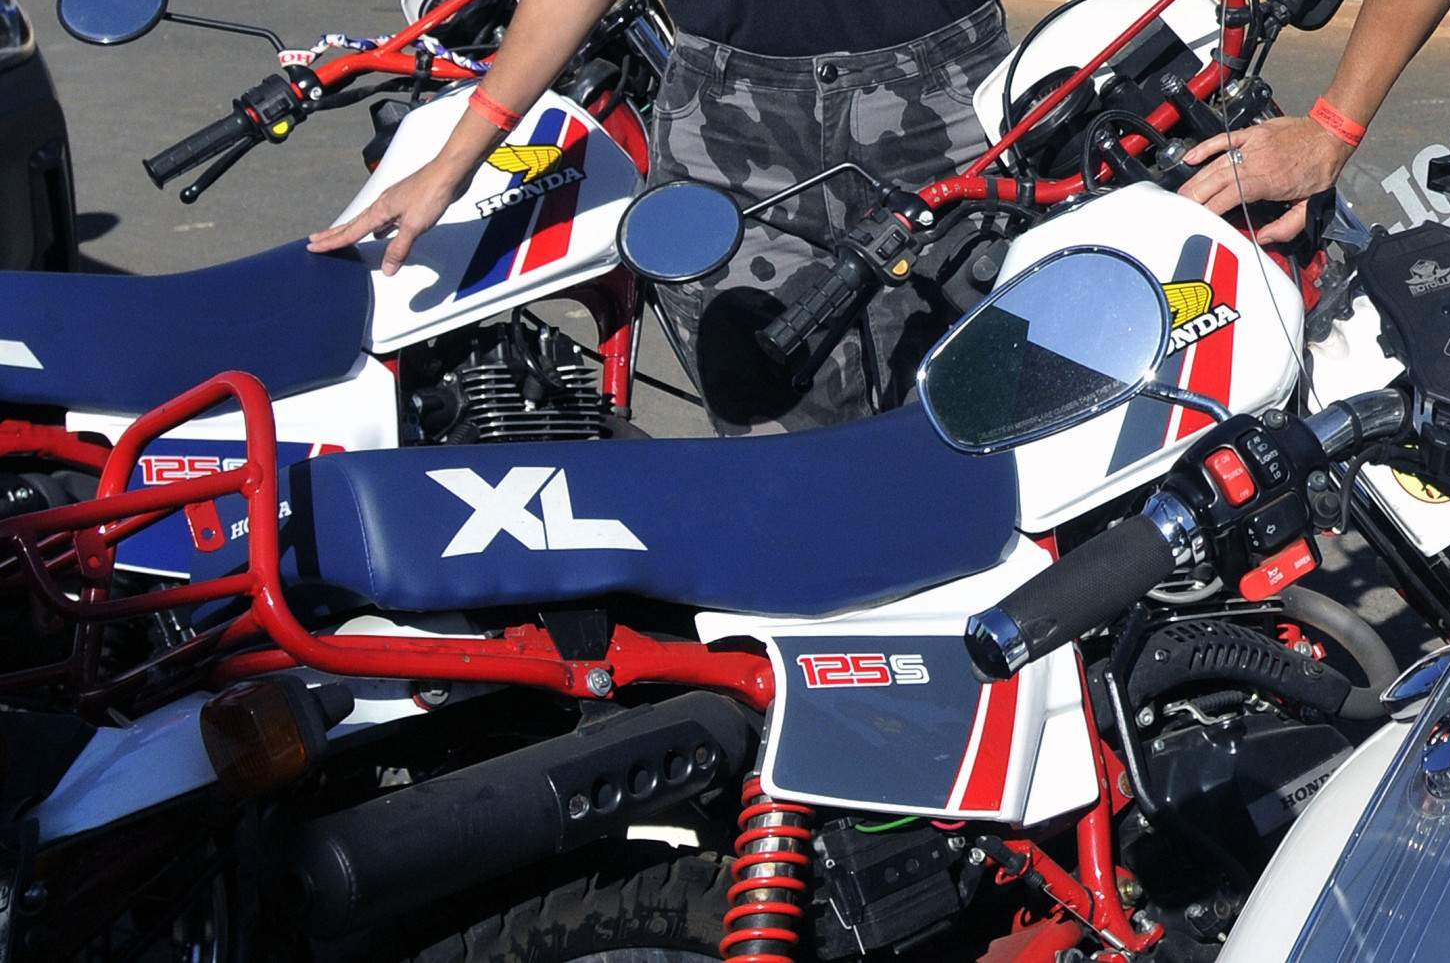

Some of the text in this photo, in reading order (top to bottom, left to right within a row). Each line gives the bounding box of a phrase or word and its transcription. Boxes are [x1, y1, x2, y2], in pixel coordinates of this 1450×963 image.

[475, 167, 586, 219] HONDA
[1166, 303, 1240, 356] NDA
[425, 467, 648, 558] XL
[796, 654, 930, 688] 125S
[1281, 768, 1337, 809] HOND
